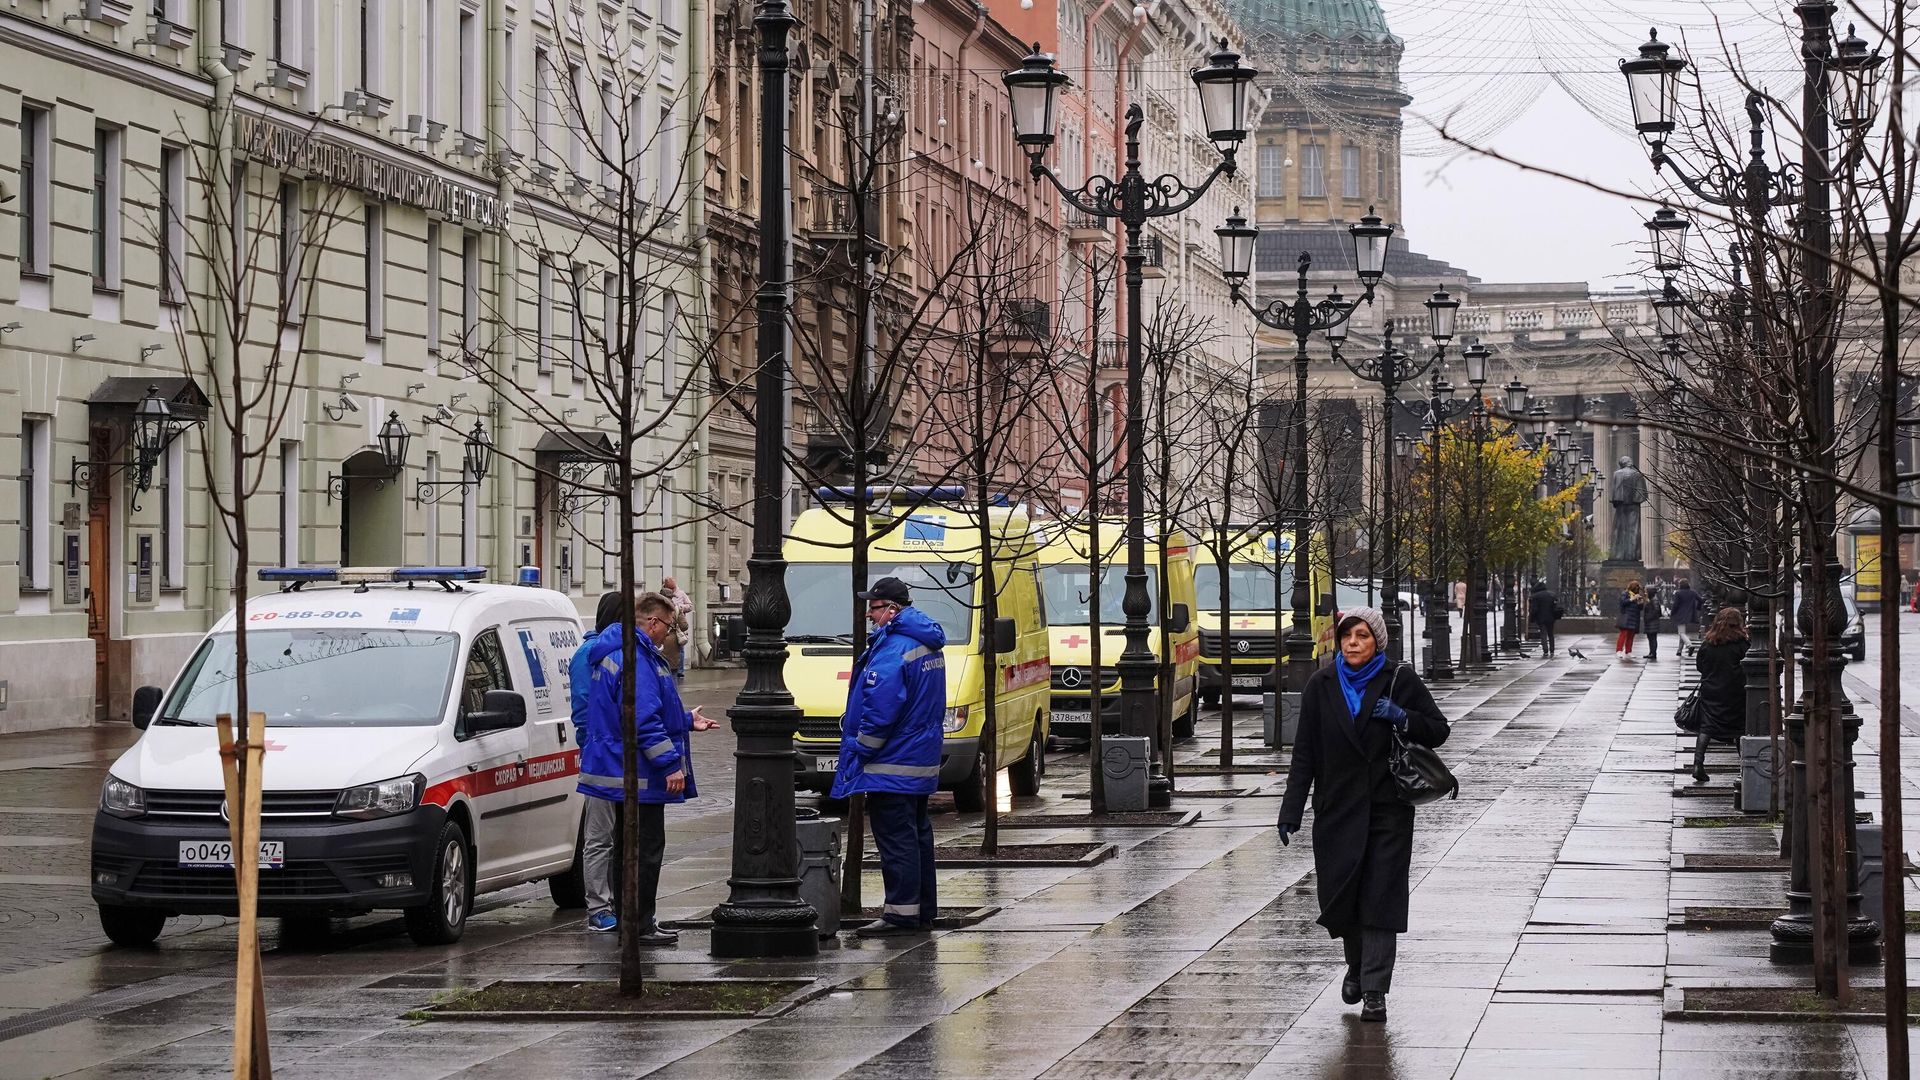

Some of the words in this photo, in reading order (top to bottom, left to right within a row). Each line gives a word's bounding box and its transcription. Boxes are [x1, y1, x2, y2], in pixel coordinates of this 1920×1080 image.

[241, 114, 360, 185] МЕЖДУНАРОДНЫЙ
[362, 155, 444, 212] МЕДИЦИНСКИЙ
[446, 183, 478, 221] ЦЕНТР
[495, 767, 517, 786] СКОРАЯ
[528, 757, 566, 779] МЕДИЦИНСКАЯ
[260, 843, 278, 856] 47
